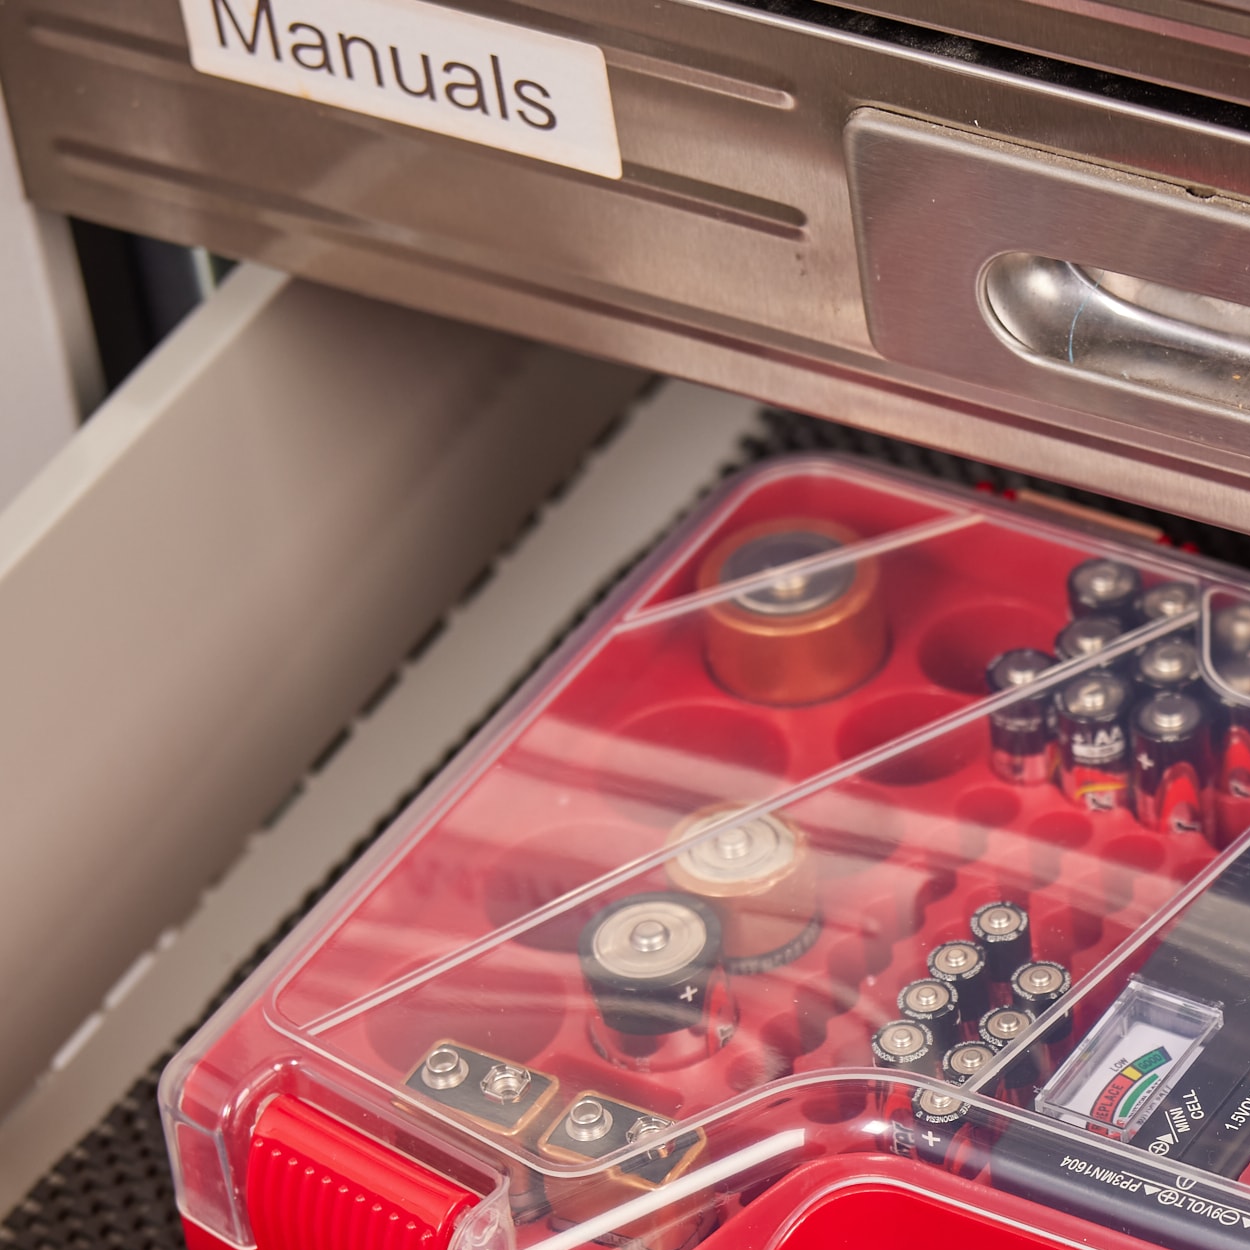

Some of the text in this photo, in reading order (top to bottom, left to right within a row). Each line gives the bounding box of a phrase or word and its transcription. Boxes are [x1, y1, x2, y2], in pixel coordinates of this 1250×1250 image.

[208, 0, 558, 132] Manuals
[1109, 1057, 1128, 1072] LOW
[1138, 1053, 1162, 1070] GOOD
[1182, 1089, 1205, 1120] CELL
[1169, 1107, 1191, 1133] MINI
[1060, 1155, 1222, 1220] 9VOLT PP3MN1604
